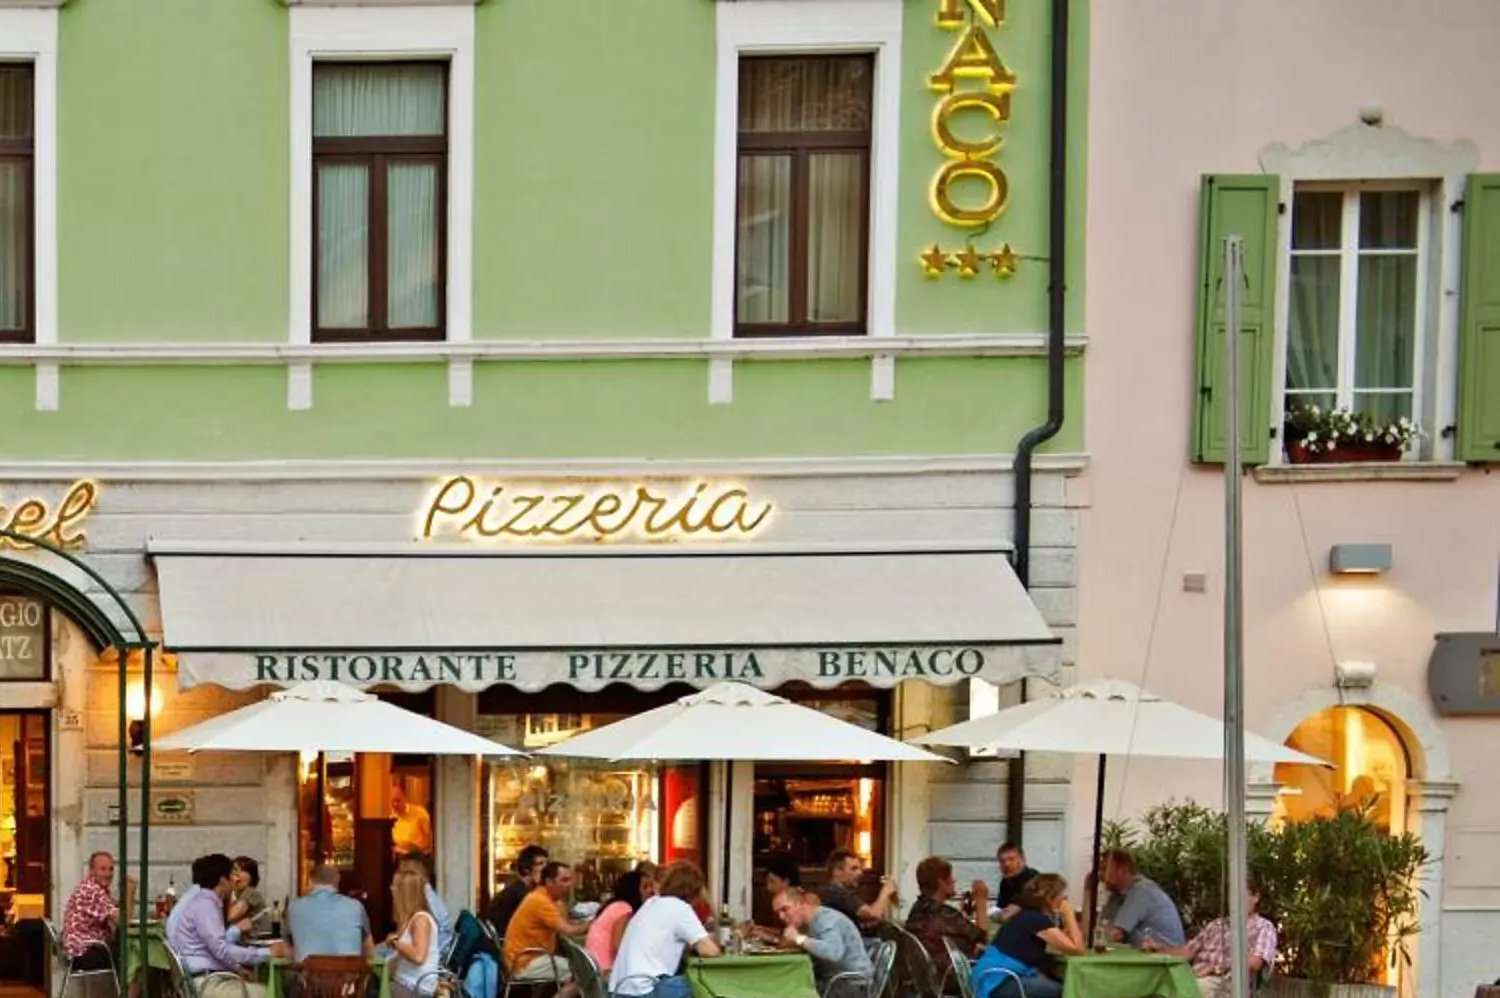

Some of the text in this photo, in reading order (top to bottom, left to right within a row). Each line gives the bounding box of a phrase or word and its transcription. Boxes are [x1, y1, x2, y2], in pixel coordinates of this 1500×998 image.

[422, 475, 775, 542] Pizzeria
[254, 647, 987, 681] RISTORANTE PIZZERIA BENACO
